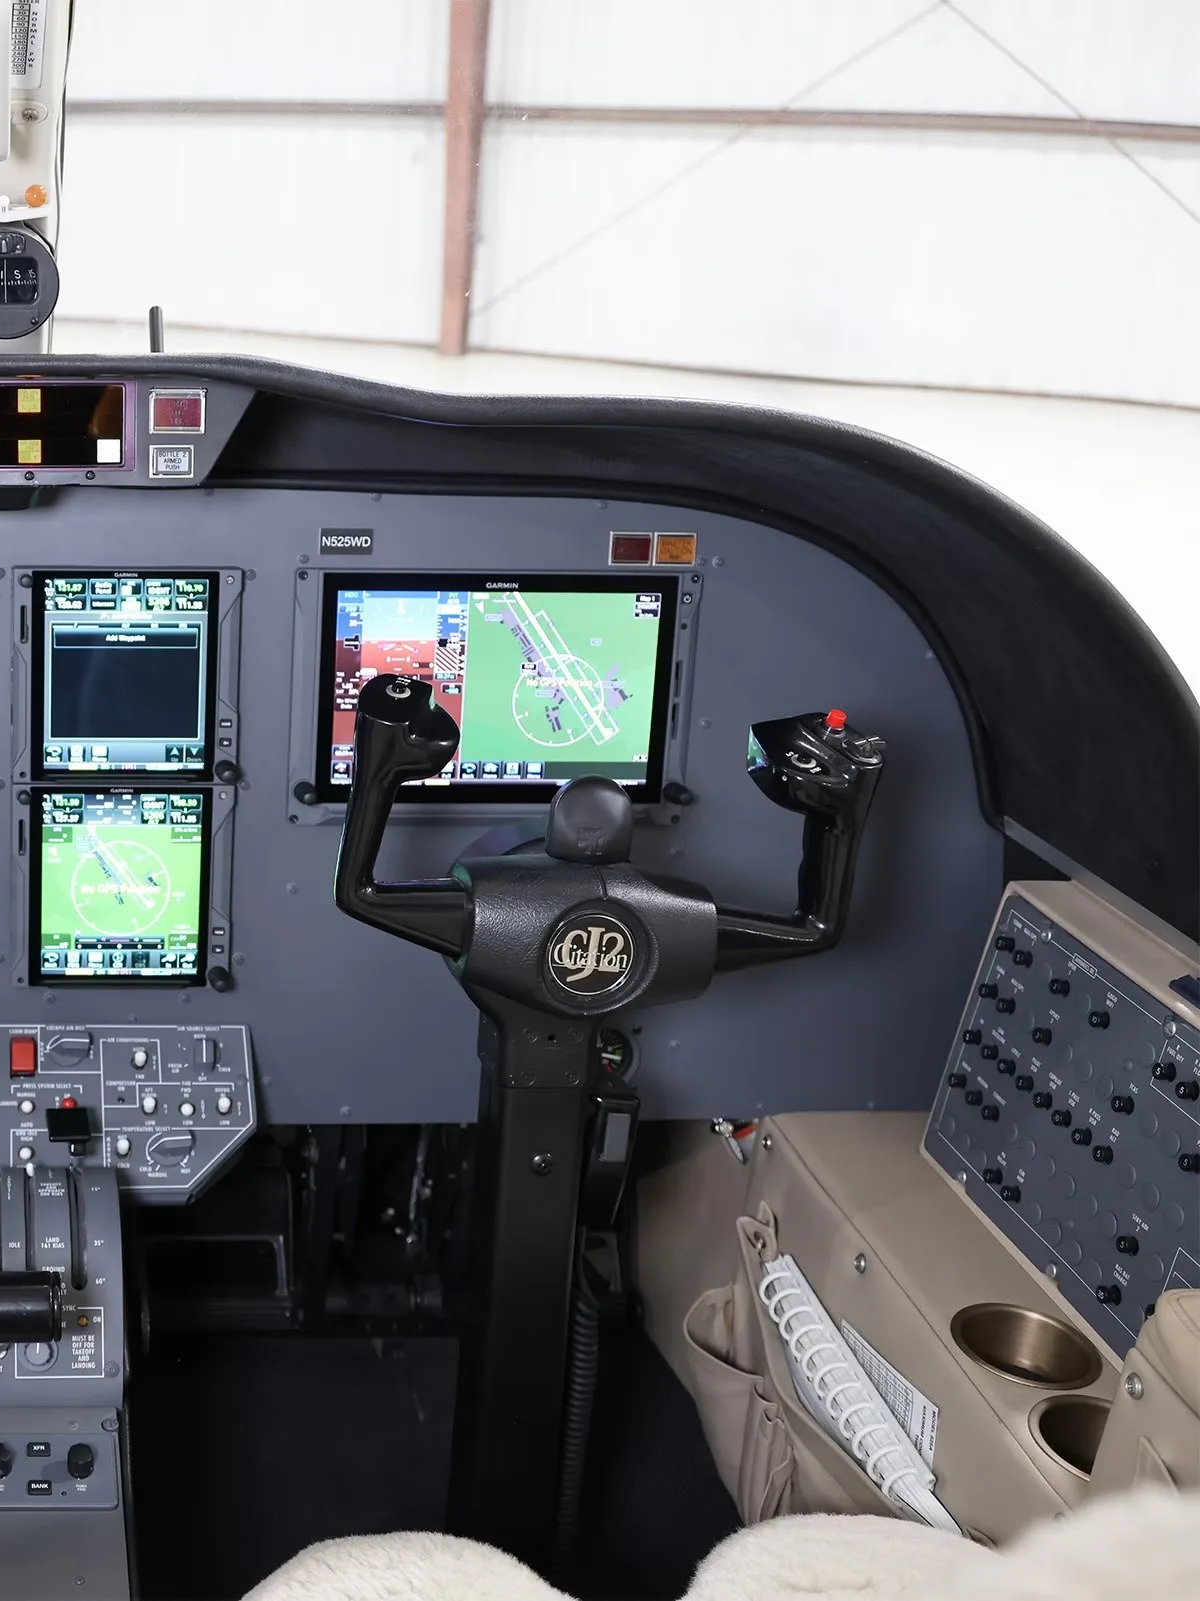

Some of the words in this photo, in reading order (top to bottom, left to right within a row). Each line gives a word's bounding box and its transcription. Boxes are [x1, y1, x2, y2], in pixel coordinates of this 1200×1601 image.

[30, 11, 38, 44] NORMAL
[13, 269, 22, 279] S
[321, 535, 372, 548] N525WD
[105, 634, 118, 642] Add
[119, 635, 146, 643] Waypoint
[553, 943, 628, 969] Citation
[561, 927, 625, 982] CJ2
[1107, 991, 1118, 1003] GOGO
[1105, 998, 1115, 1009] WIFI
[1166, 1046, 1175, 1057] FUEL
[1175, 1053, 1184, 1063] QTY
[1155, 1067, 1161, 1075] 5
[1048, 1071, 1062, 1086] COPILOT
[1049, 1080, 1057, 1090] USB
[1129, 1083, 1139, 1094] TCAS
[1068, 1098, 1076, 1107] USB
[1089, 1116, 1097, 1126] USB
[1093, 1111, 1101, 1122] PASS
[1111, 1127, 1120, 1137] RAD
[1109, 1134, 1117, 1143] ALT
[1132, 1213, 1141, 1225] STBY
[1141, 1222, 1150, 1231] ADI
[1119, 1241, 1125, 1249] 5
[1113, 1270, 1128, 1287] CHARGE
